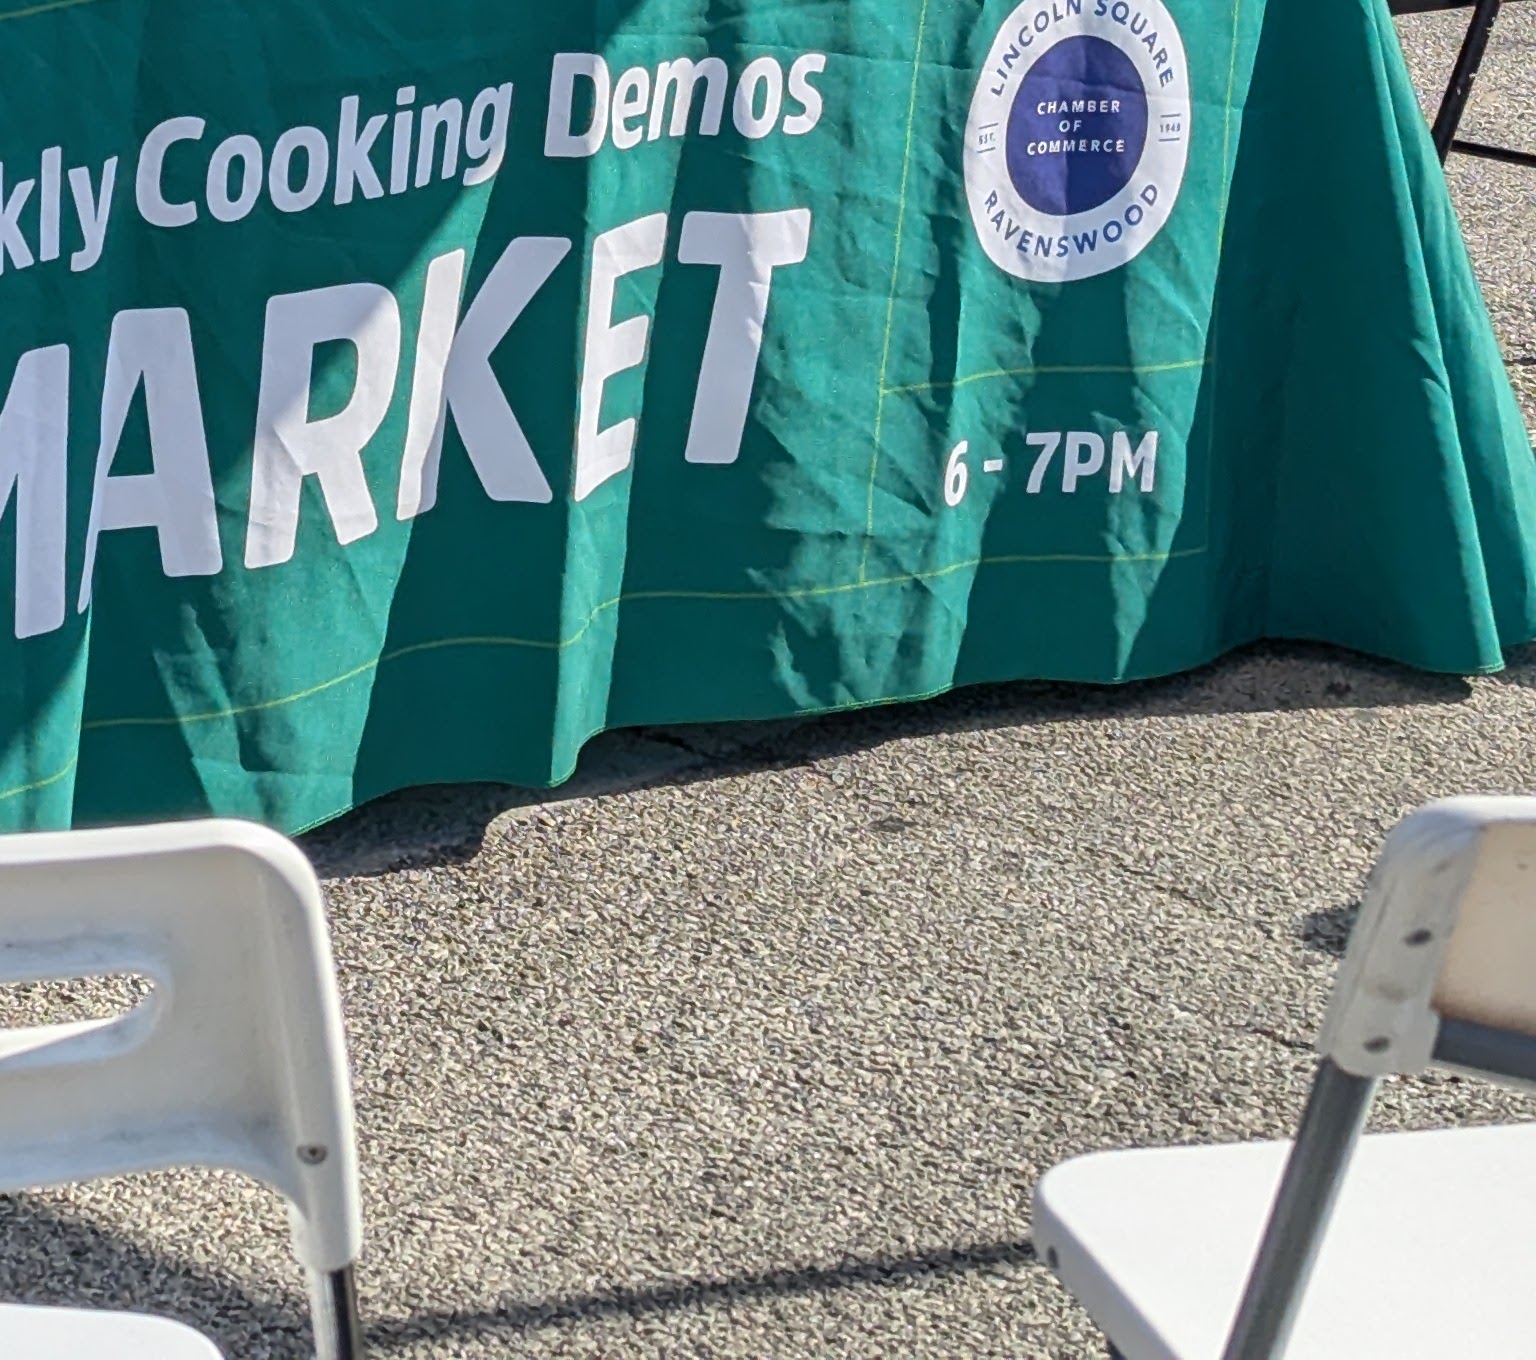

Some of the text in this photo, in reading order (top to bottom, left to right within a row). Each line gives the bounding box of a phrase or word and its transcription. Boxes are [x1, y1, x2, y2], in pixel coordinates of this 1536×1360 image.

[1037, 100, 1121, 115] CHAMBER
[1059, 120, 1083, 133] OF
[136, 82, 514, 227] Cooking
[544, 52, 826, 158] Demos
[1027, 138, 1125, 155] COMMERCE
[984, 183, 1159, 258] RAVENSWOOD
[944, 439, 969, 507] 6
[1025, 430, 1159, 494] 7PM
